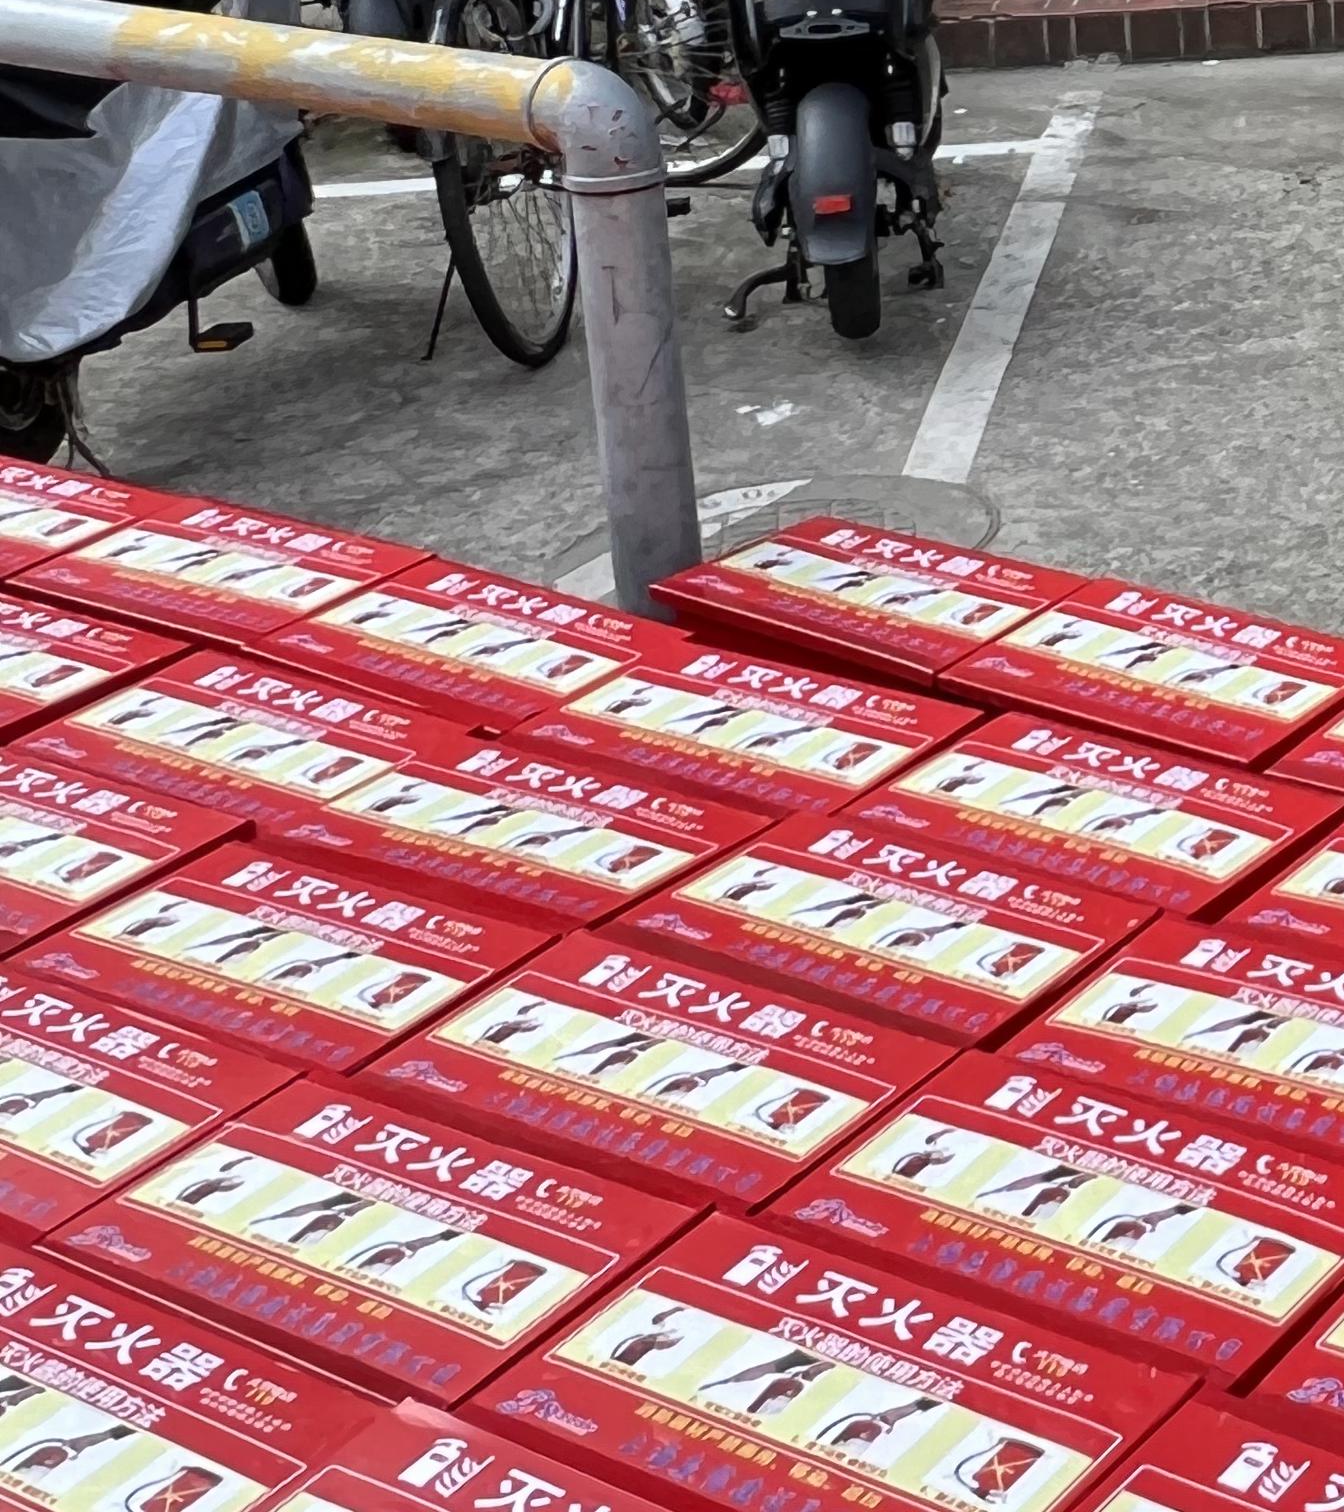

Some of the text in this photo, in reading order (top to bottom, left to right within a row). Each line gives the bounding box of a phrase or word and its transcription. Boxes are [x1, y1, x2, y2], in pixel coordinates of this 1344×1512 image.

[734, 666, 862, 710] 灭火器
[12, 766, 130, 816] 灭火器
[508, 762, 649, 810] 灭火器
[1063, 742, 1210, 790] 灭火器
[274, 876, 427, 931] 灭火器
[864, 842, 1018, 902] 灭火器
[2, 994, 161, 1060] 灭火器
[638, 972, 806, 1040] 灭火器
[356, 1124, 533, 1202] 灭火器
[1054, 1094, 1248, 1176] 灭火器
[30, 1294, 224, 1390] 灭火器
[796, 1272, 1004, 1366] 灭火器
[0, 1340, 166, 1428] 灭火器的使用方法
[768, 1316, 964, 1400] 灭火器的使用方法
